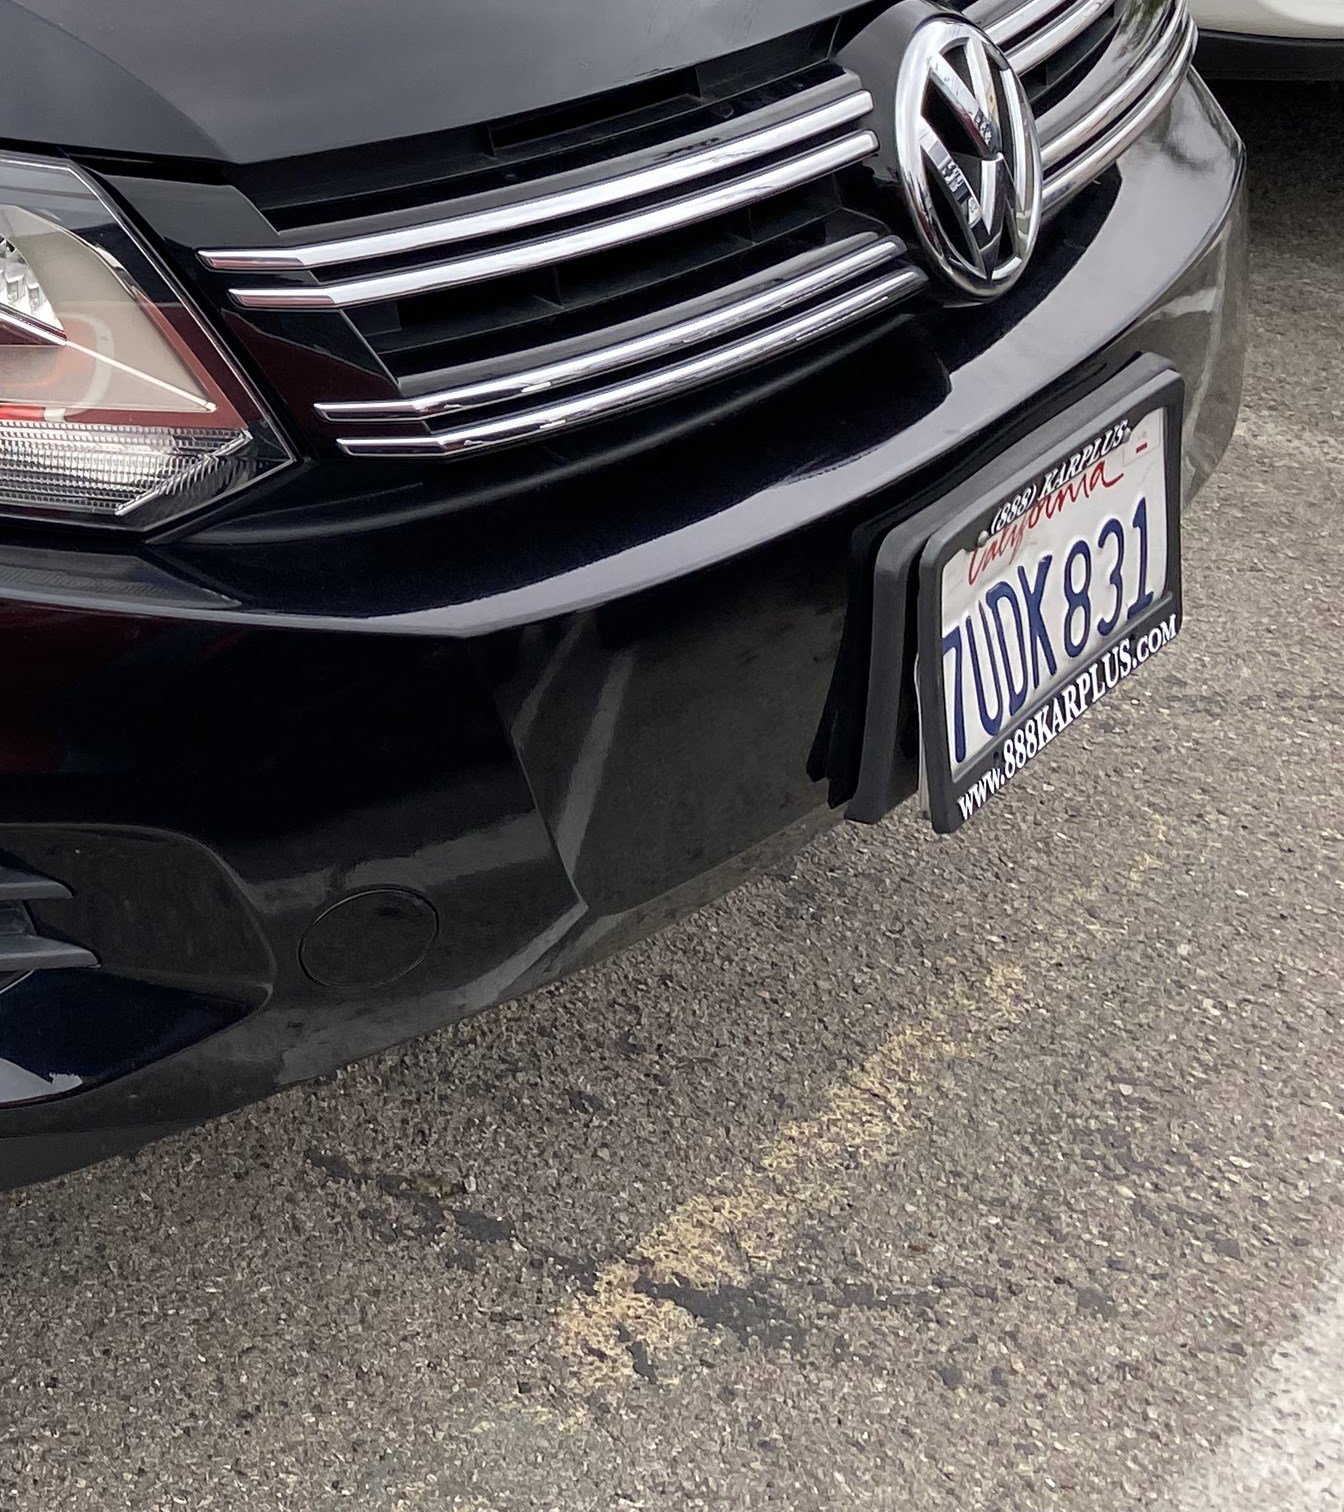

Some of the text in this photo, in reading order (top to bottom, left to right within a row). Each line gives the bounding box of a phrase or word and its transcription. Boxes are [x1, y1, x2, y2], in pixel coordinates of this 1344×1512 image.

[990, 419, 1128, 535] (888) KARPLUS
[942, 496, 1154, 764] 7UDK831
